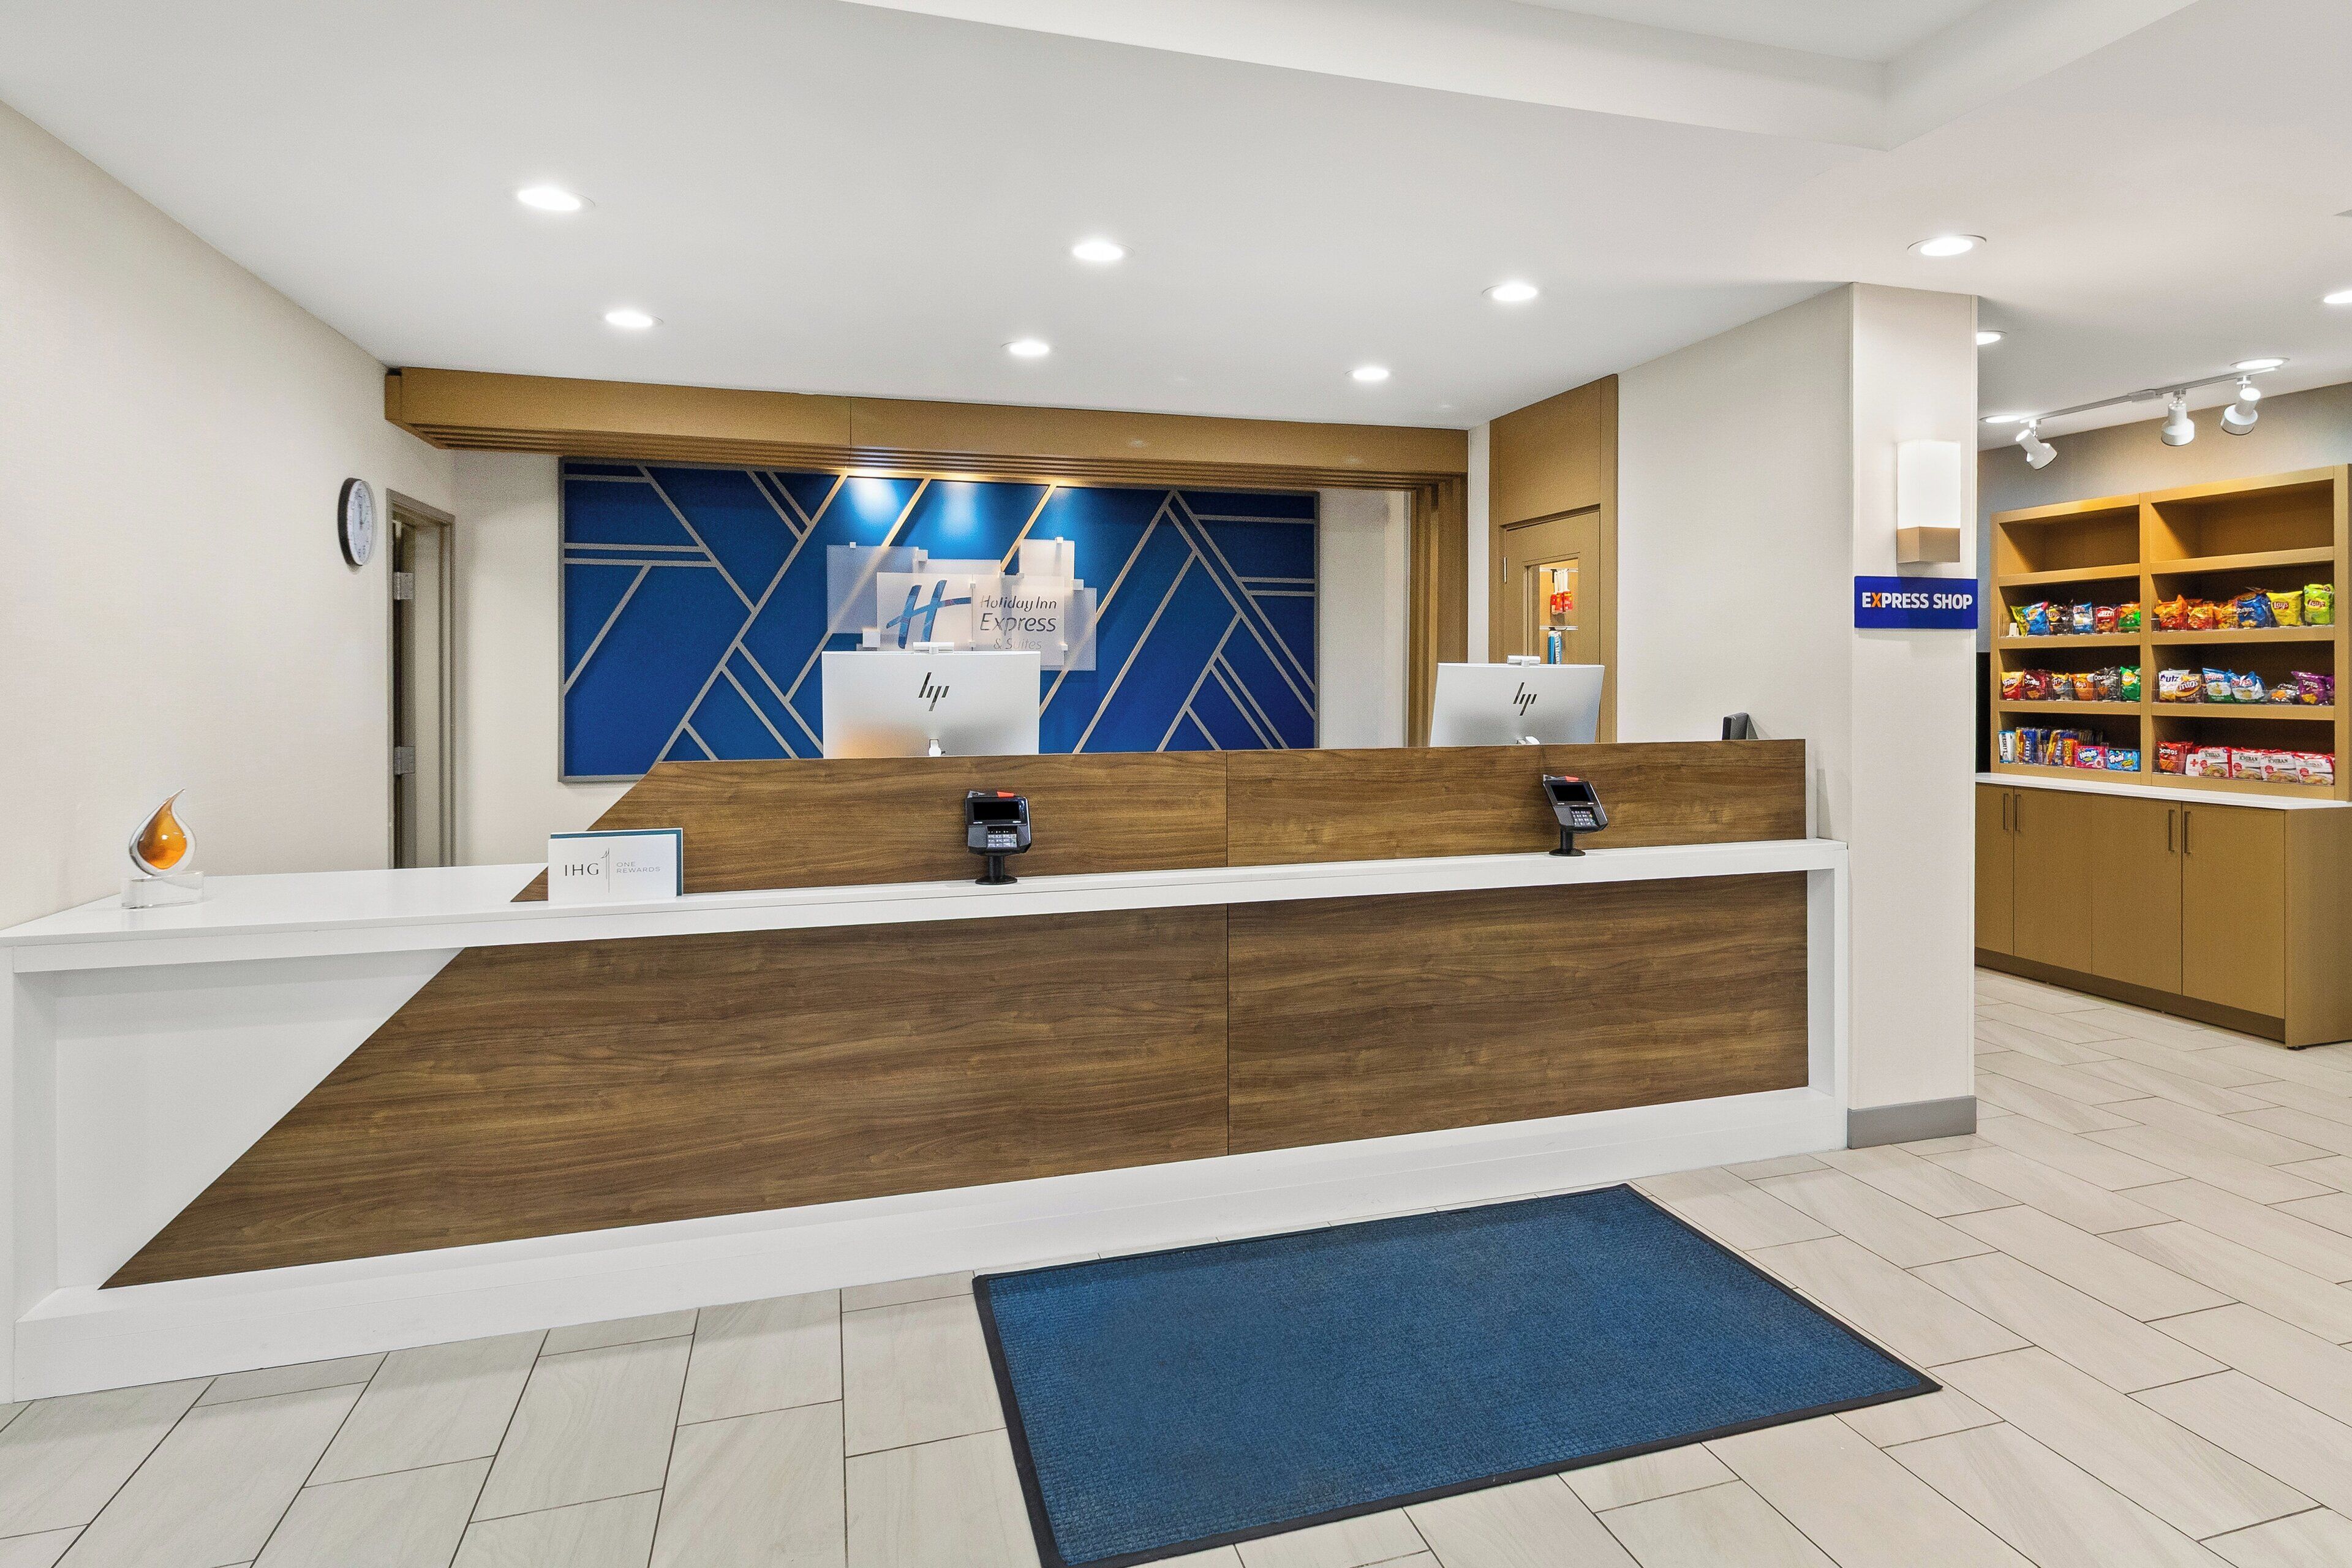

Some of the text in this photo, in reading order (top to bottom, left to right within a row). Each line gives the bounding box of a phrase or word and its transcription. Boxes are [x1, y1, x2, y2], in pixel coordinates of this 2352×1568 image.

[980, 595, 1057, 612] Holiday Inn
[1862, 592, 1973, 609] EXPRESS SHOP
[980, 612, 1057, 636] Express
[993, 638, 1042, 650] & Suites
[565, 863, 599, 876] IHG
